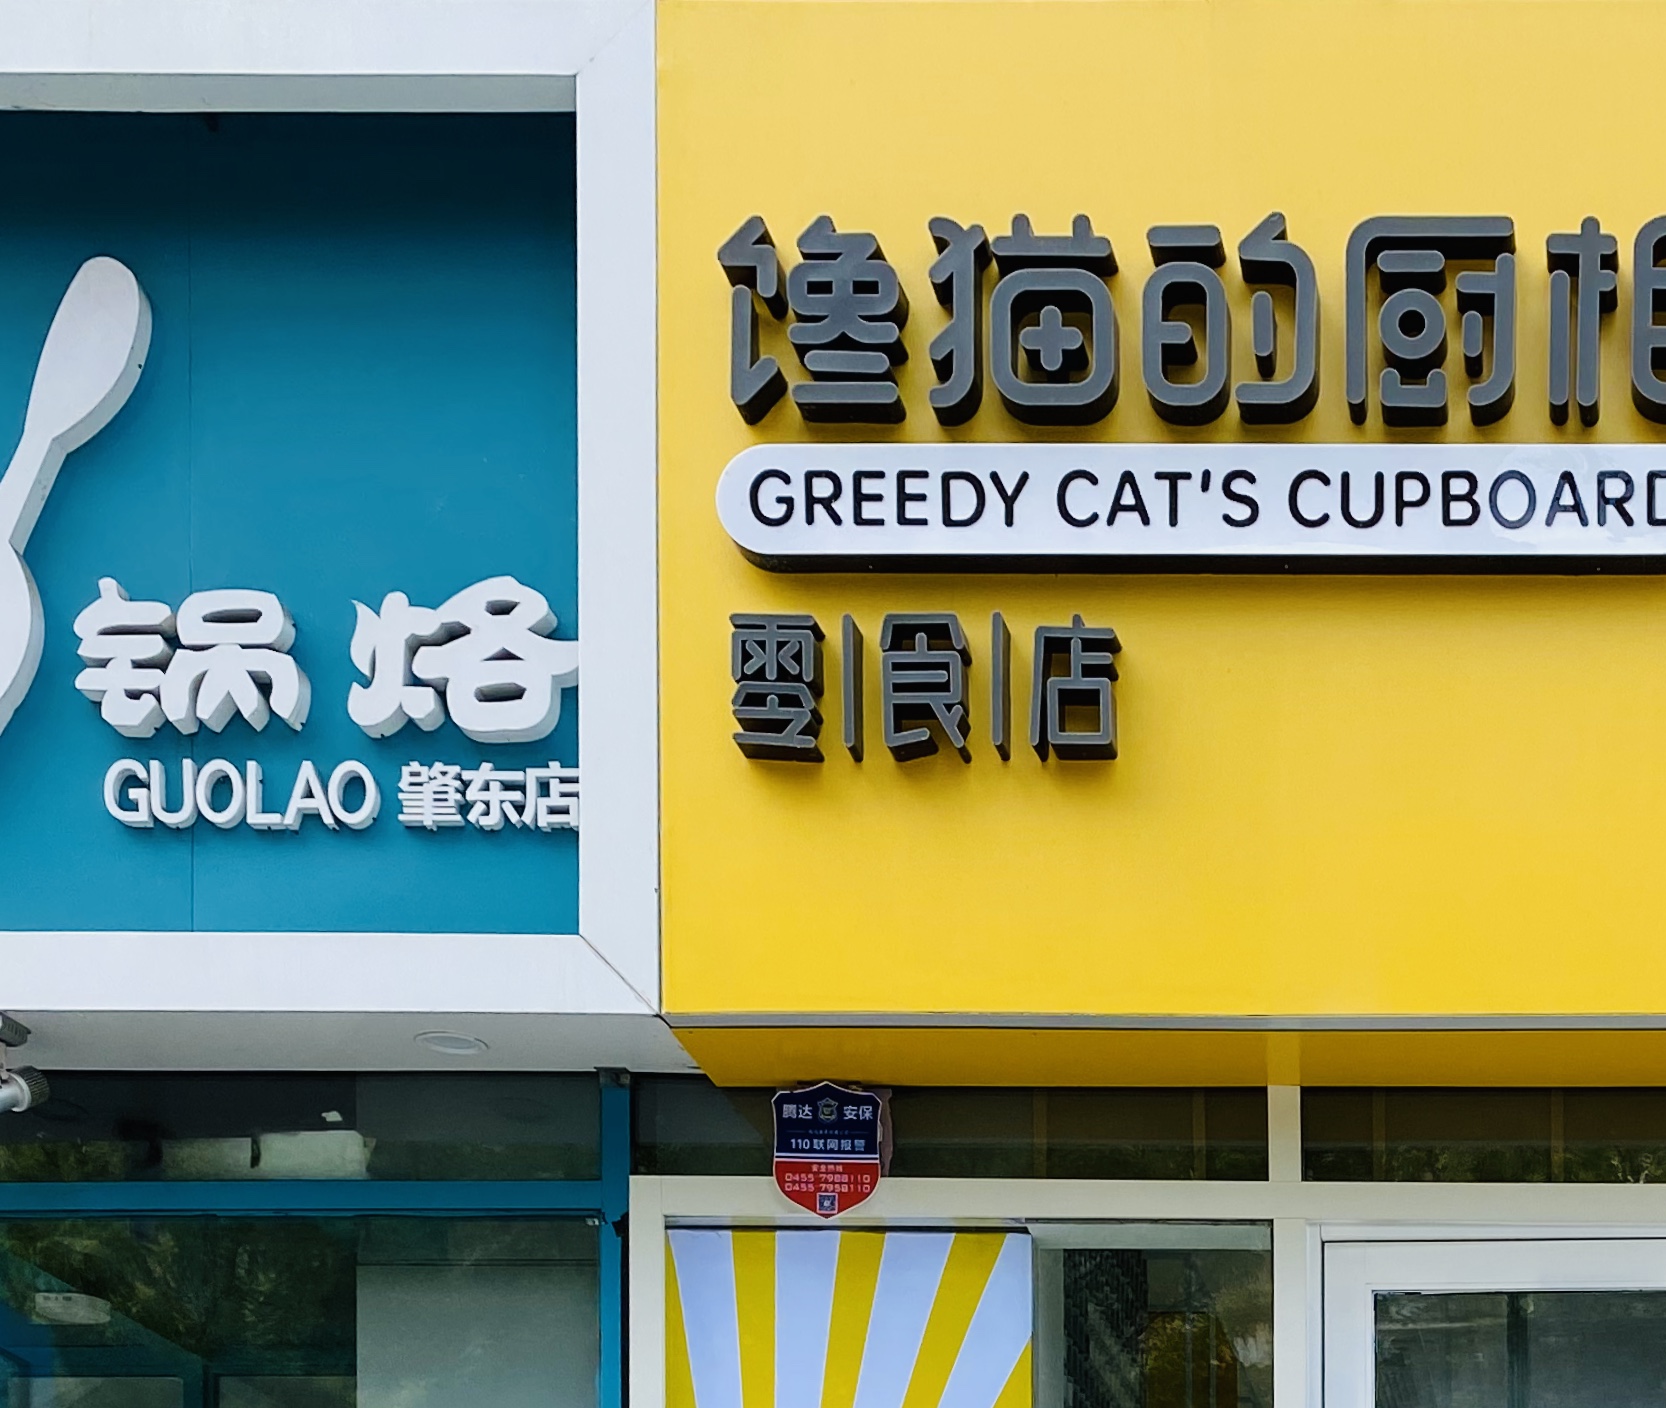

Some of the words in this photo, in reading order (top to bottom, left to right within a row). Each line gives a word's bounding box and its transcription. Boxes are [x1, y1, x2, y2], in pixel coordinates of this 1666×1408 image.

[748, 469, 1028, 529] GREEDY
[1056, 469, 1261, 528] CAT'S
[103, 759, 380, 831] GUOLAO
[397, 761, 579, 832] 肇东店
[843, 1105, 874, 1121] 安保
[785, 1173, 815, 1182] 0455
[785, 1184, 815, 1192] 0455
